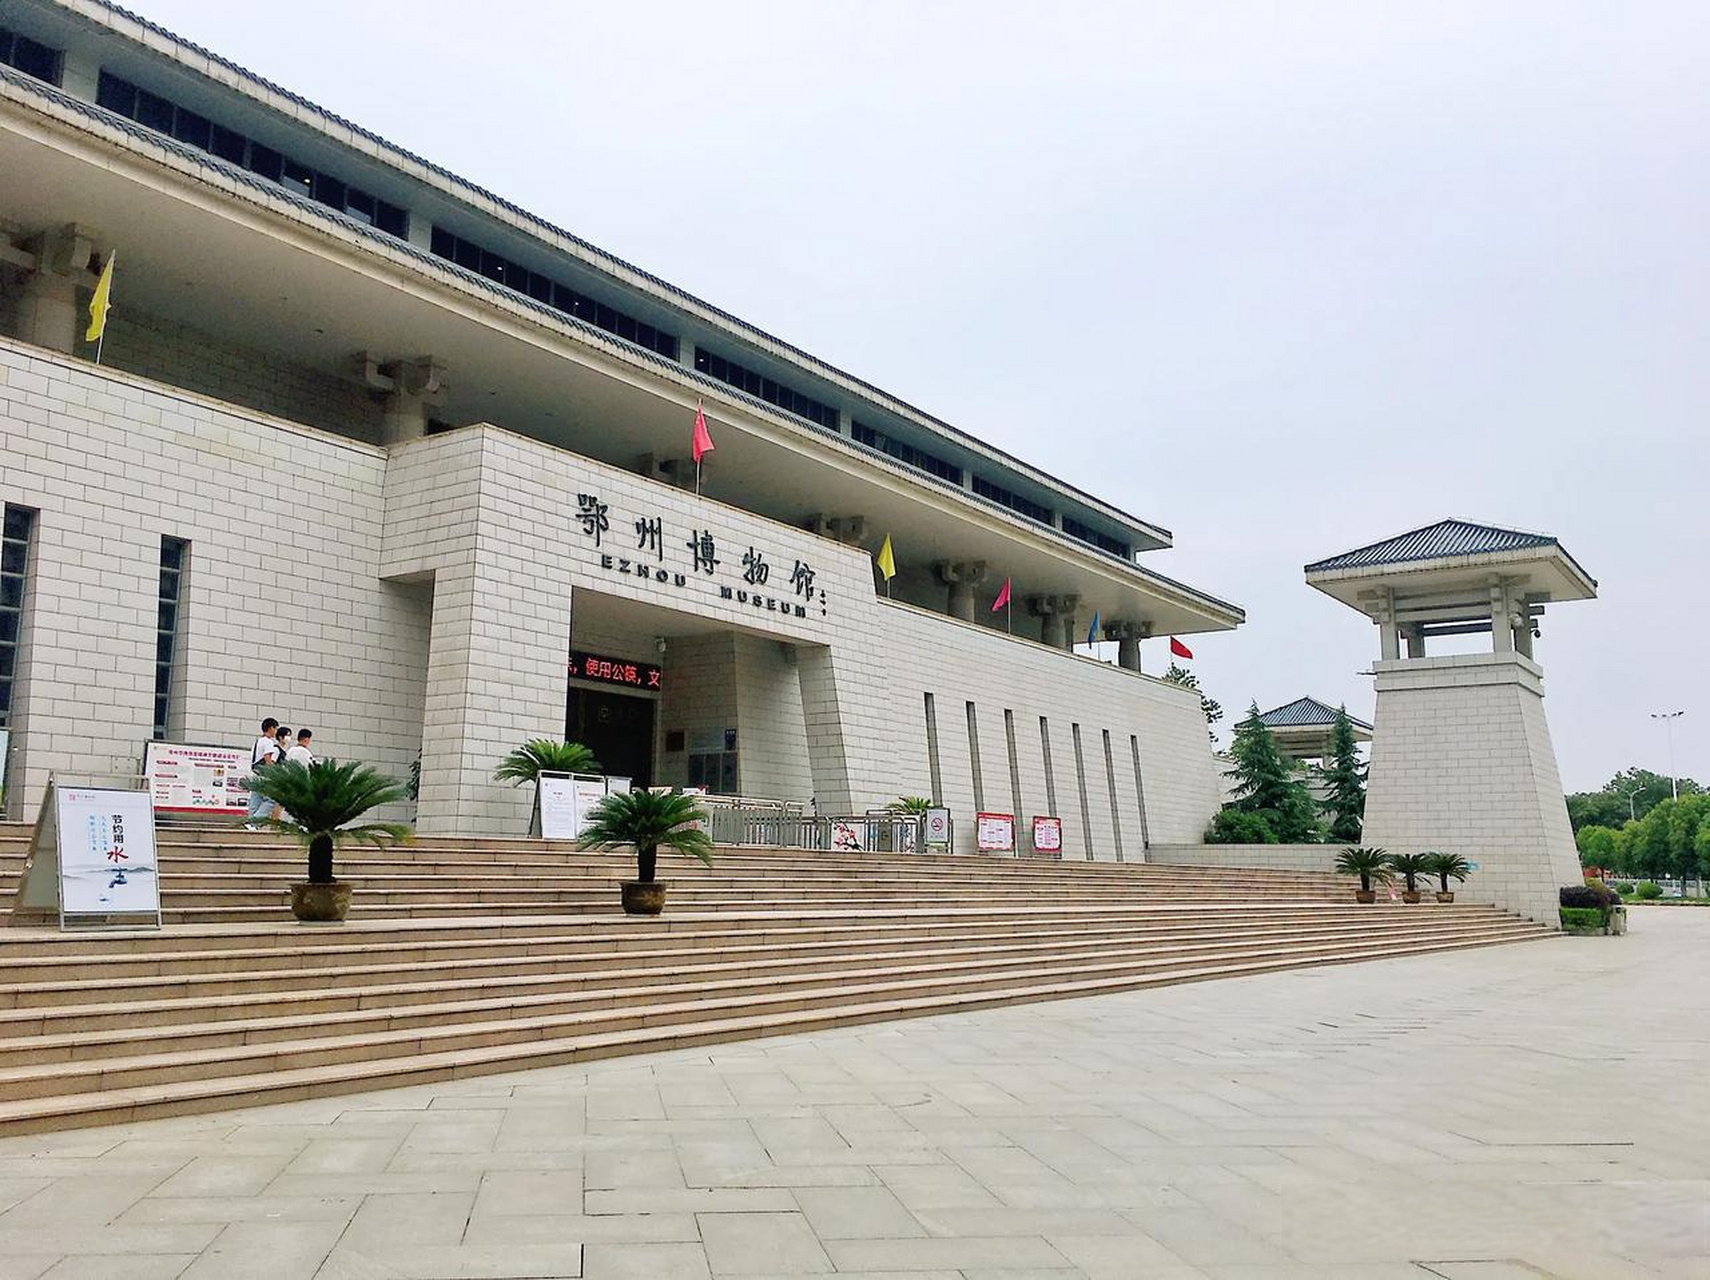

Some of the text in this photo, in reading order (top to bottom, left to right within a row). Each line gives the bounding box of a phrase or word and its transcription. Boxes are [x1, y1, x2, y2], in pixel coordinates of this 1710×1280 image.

[575, 493, 816, 601] 鄂州博物馆
[601, 554, 686, 587] EZHOU
[720, 585, 806, 618] MUSEUM
[106, 814, 129, 863] 节约用水
